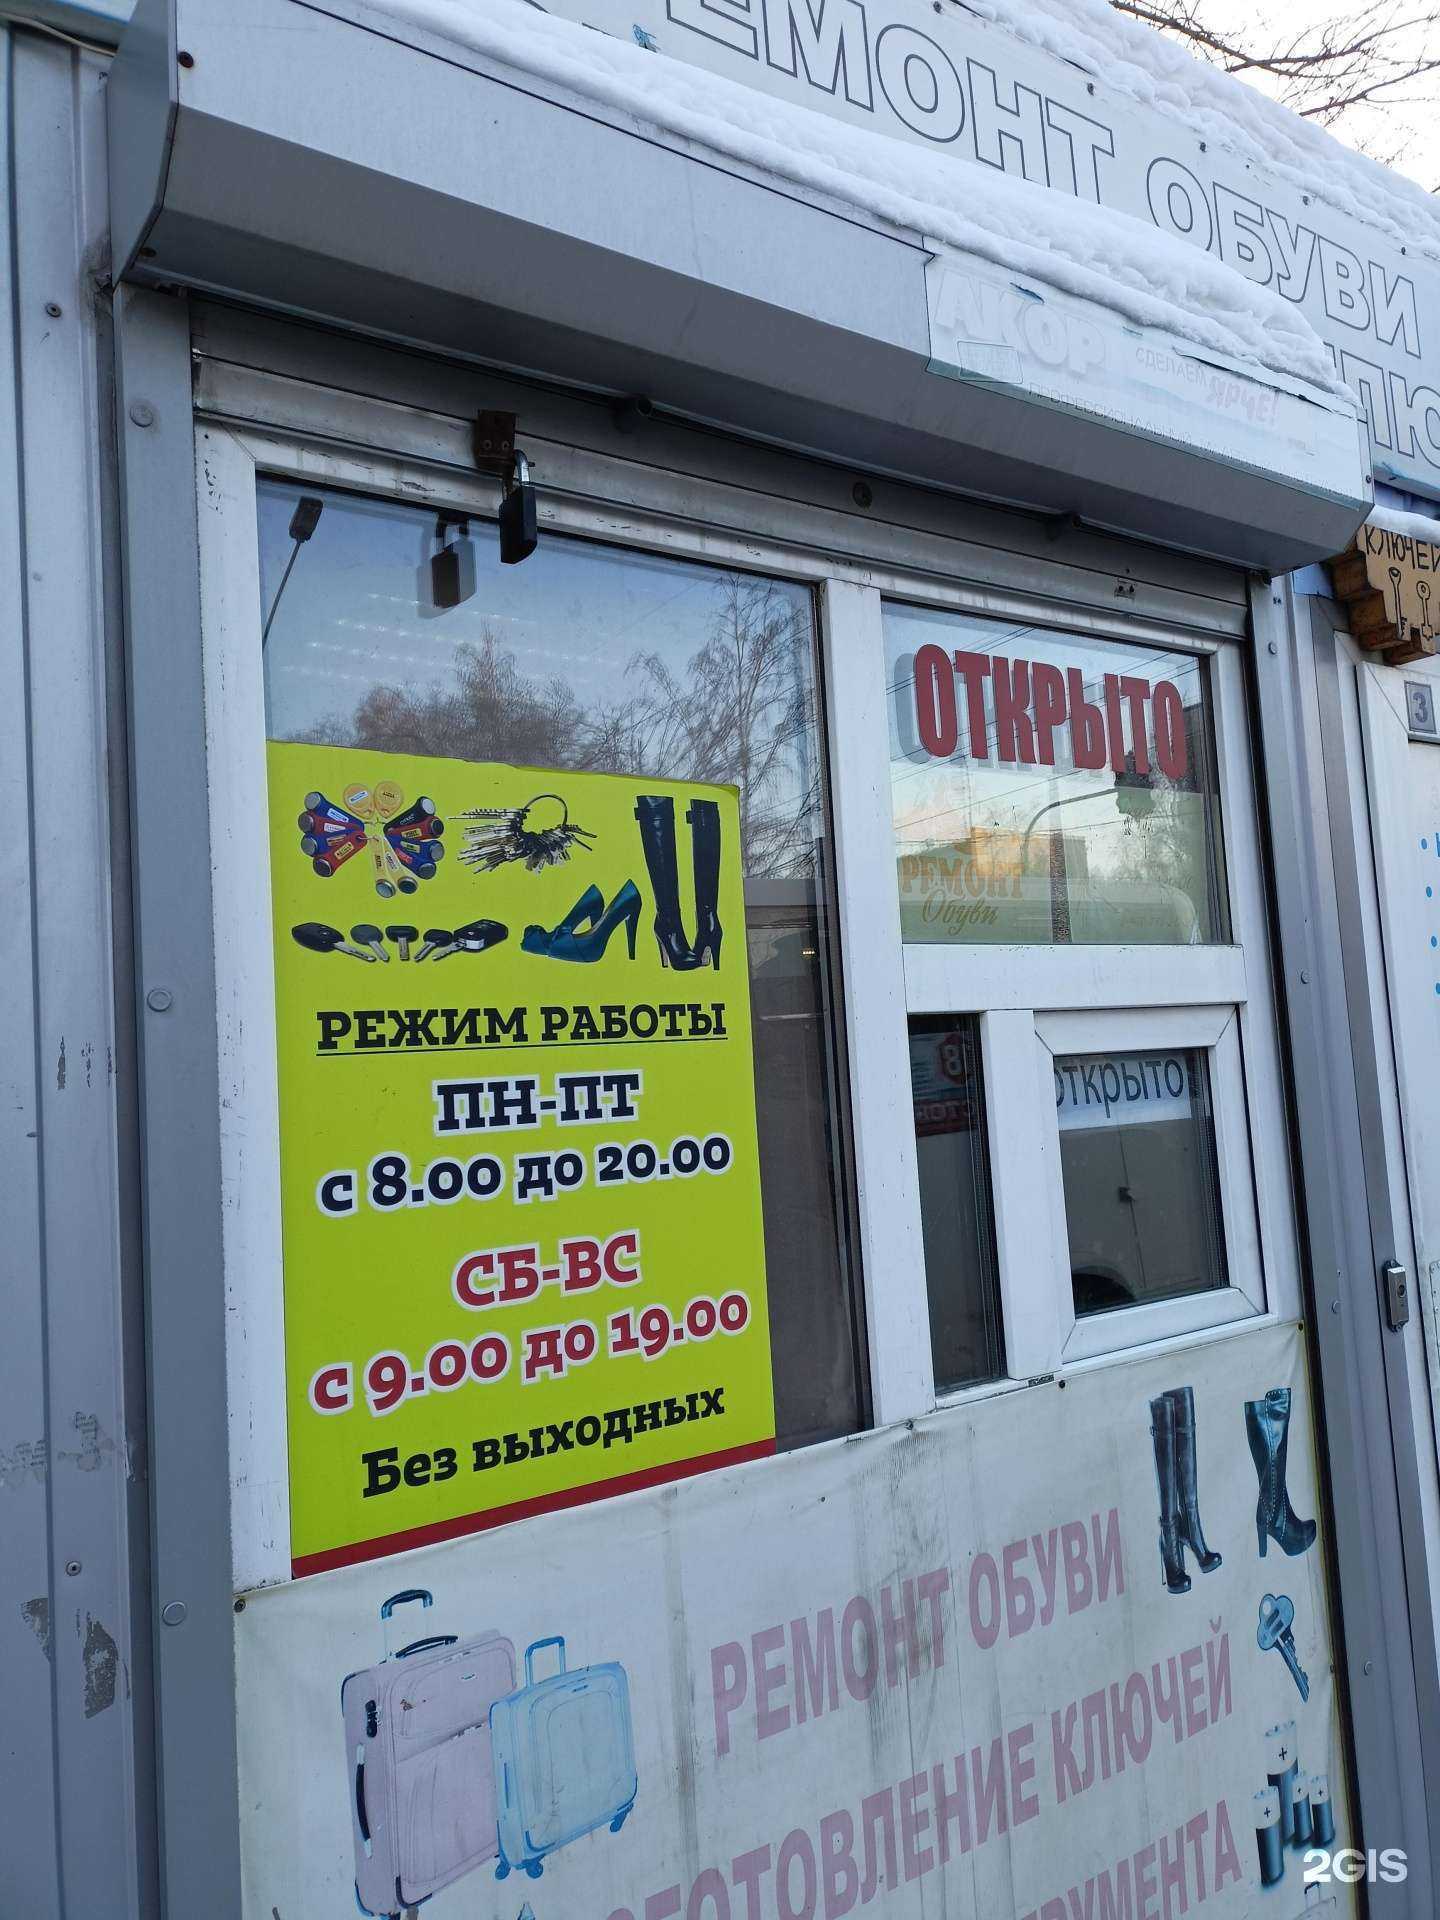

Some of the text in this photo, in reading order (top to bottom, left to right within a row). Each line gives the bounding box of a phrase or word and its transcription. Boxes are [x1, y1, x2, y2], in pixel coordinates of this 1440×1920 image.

[1146, 157, 1421, 358] ОБУВИ
[914, 643, 1187, 780] ОТКРЫТО
[1412, 691, 1430, 724] 3
[900, 854, 1025, 899] РЕМОНТ
[922, 888, 998, 935] Обуви
[316, 1003, 727, 1050] РЕЖИМ РАБОТЫ
[435, 1072, 641, 1132] ПН-ПТ
[371, 1155, 502, 1207] 8.00
[518, 1152, 584, 1200] до
[598, 1136, 731, 1182] 20.00
[455, 1234, 640, 1307] СБ-ВС
[367, 1336, 508, 1412] 9.00
[523, 1323, 595, 1380] до
[609, 1293, 749, 1357] 19.00
[361, 1386, 726, 1499] Без выходных
[710, 1507, 1125, 1759] РЕМОНТ ОБУВИ
[605, 1616, 1232, 1920] ТОВЛЕНИЕ КЛЮЧЕЙ
